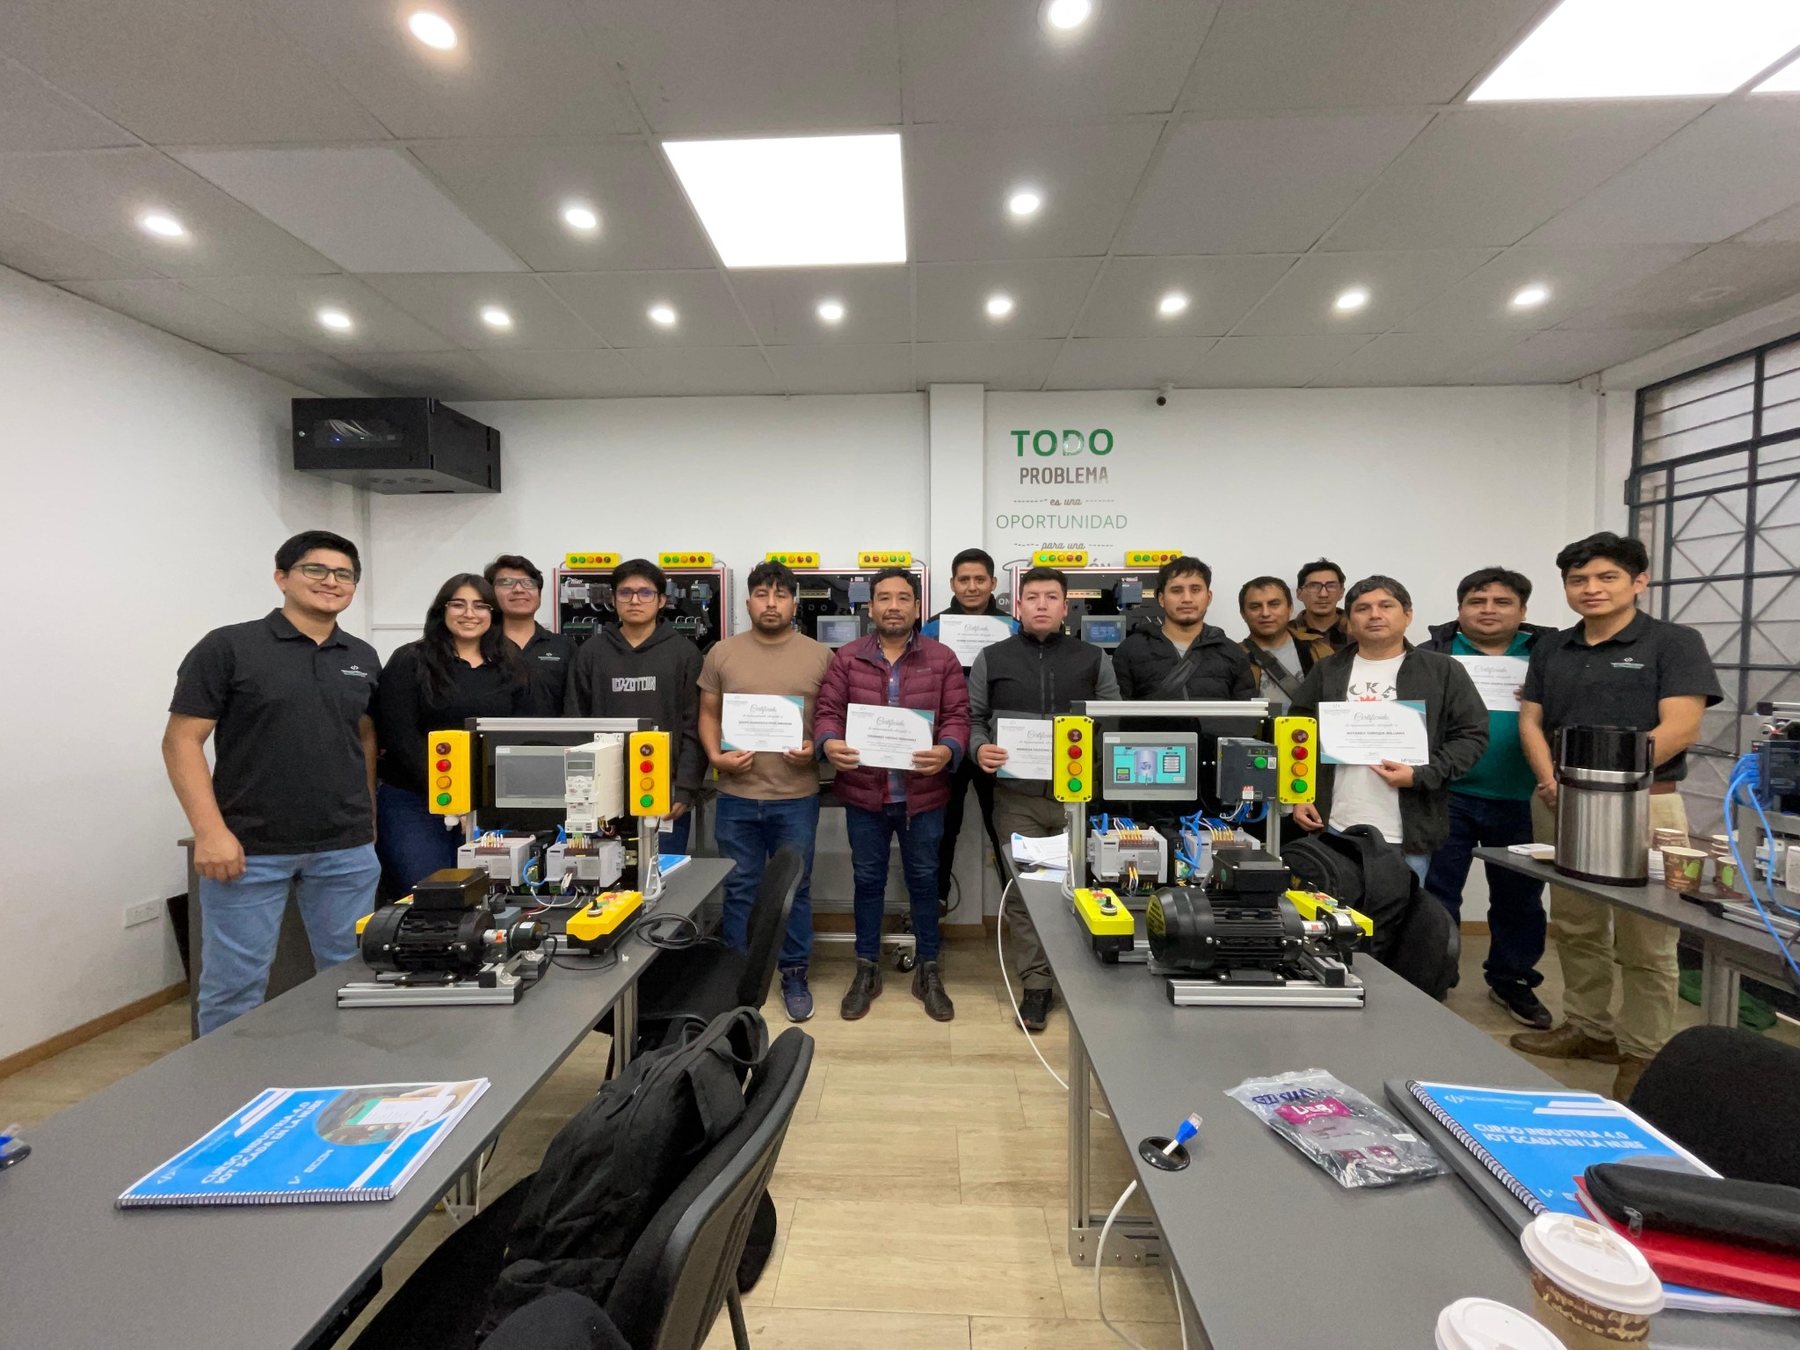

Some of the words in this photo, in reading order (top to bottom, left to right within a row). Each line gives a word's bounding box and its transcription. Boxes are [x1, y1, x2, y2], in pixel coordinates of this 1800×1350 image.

[1010, 428, 1114, 457] TODO
[1019, 466, 1110, 485] PROBLEMA
[1050, 498, 1062, 506] es
[1064, 498, 1082, 506] una
[996, 514, 1128, 529] OPORTUNIDAD
[1041, 541, 1065, 550] para
[1067, 542, 1086, 550] una
[1472, 1123, 1525, 1134] CURSO
[1524, 1127, 1605, 1140] INDUSTRIA
[1604, 1130, 1631, 1141] 4.0
[201, 1154, 244, 1184] CURSO
[238, 1114, 297, 1154] INDUSTRIA
[1482, 1132, 1509, 1143] IOT
[1510, 1135, 1564, 1147] SCADA
[1560, 1138, 1585, 1148] EN
[1583, 1138, 1608, 1149] LA
[1603, 1140, 1649, 1151] NUBE
